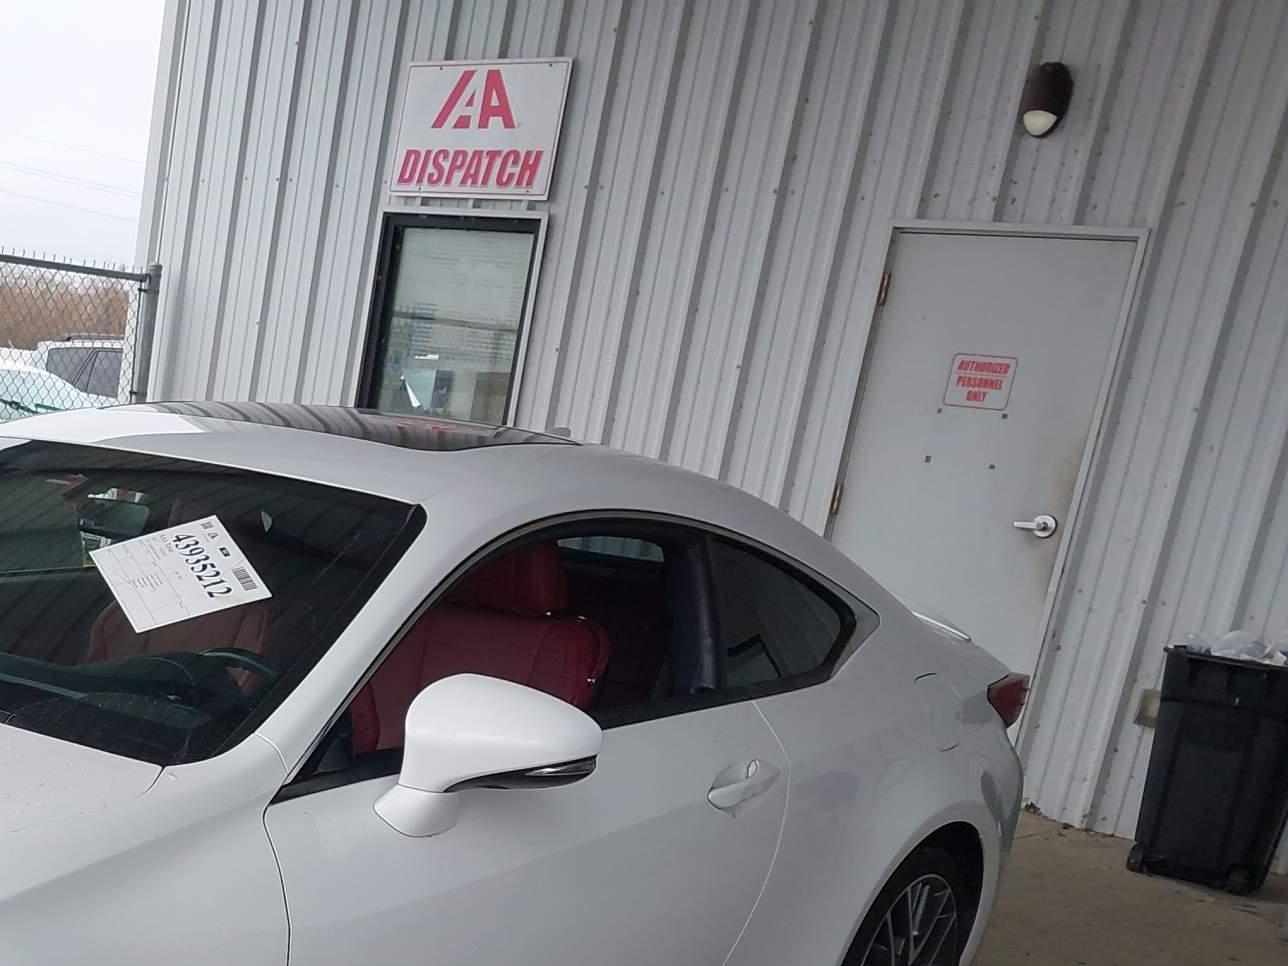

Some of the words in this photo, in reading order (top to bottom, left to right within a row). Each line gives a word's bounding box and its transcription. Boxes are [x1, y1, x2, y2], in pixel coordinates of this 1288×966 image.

[396, 149, 544, 188] DISPATCH
[957, 360, 1010, 375] AUTHORIZED
[956, 375, 1003, 390] PERSONNEL
[966, 390, 988, 402] ONLY
[172, 534, 233, 598] 43935212
